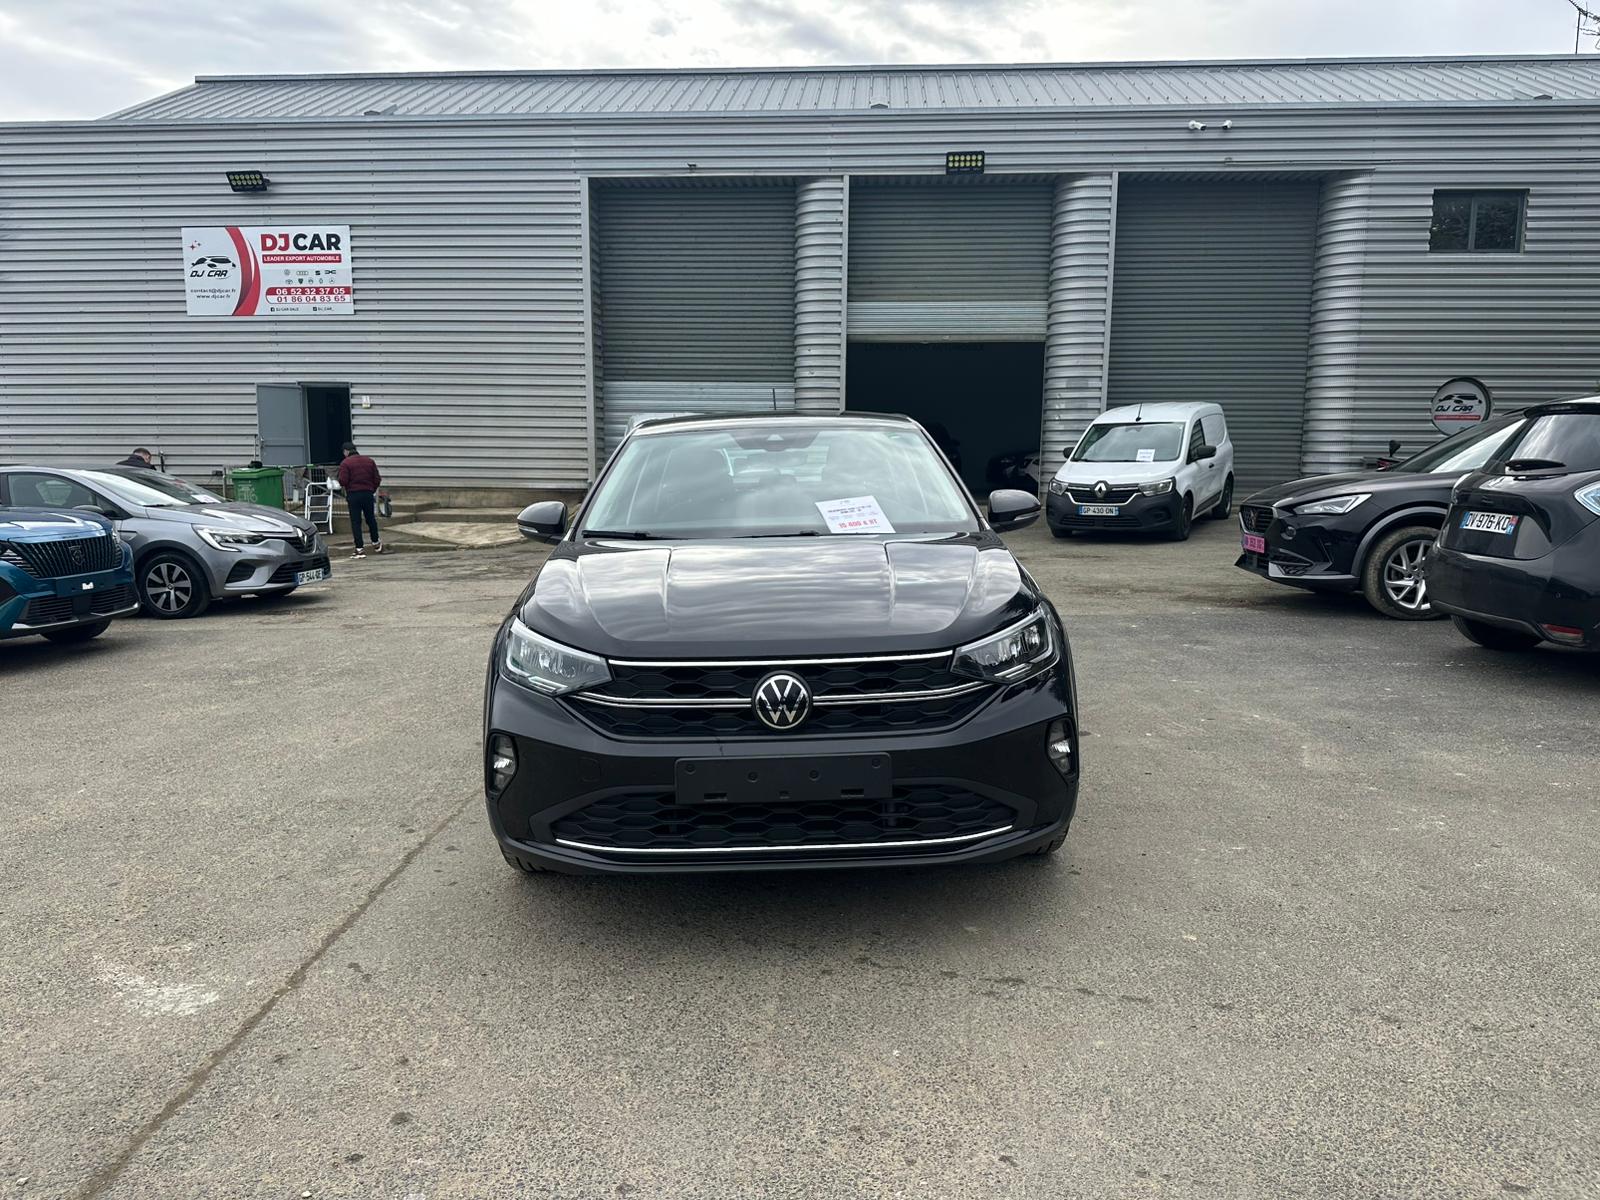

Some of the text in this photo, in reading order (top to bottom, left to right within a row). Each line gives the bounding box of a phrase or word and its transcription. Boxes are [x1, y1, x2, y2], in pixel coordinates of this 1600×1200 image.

[261, 233, 341, 251] DJ CAR
[190, 270, 228, 278] DJ CAR
